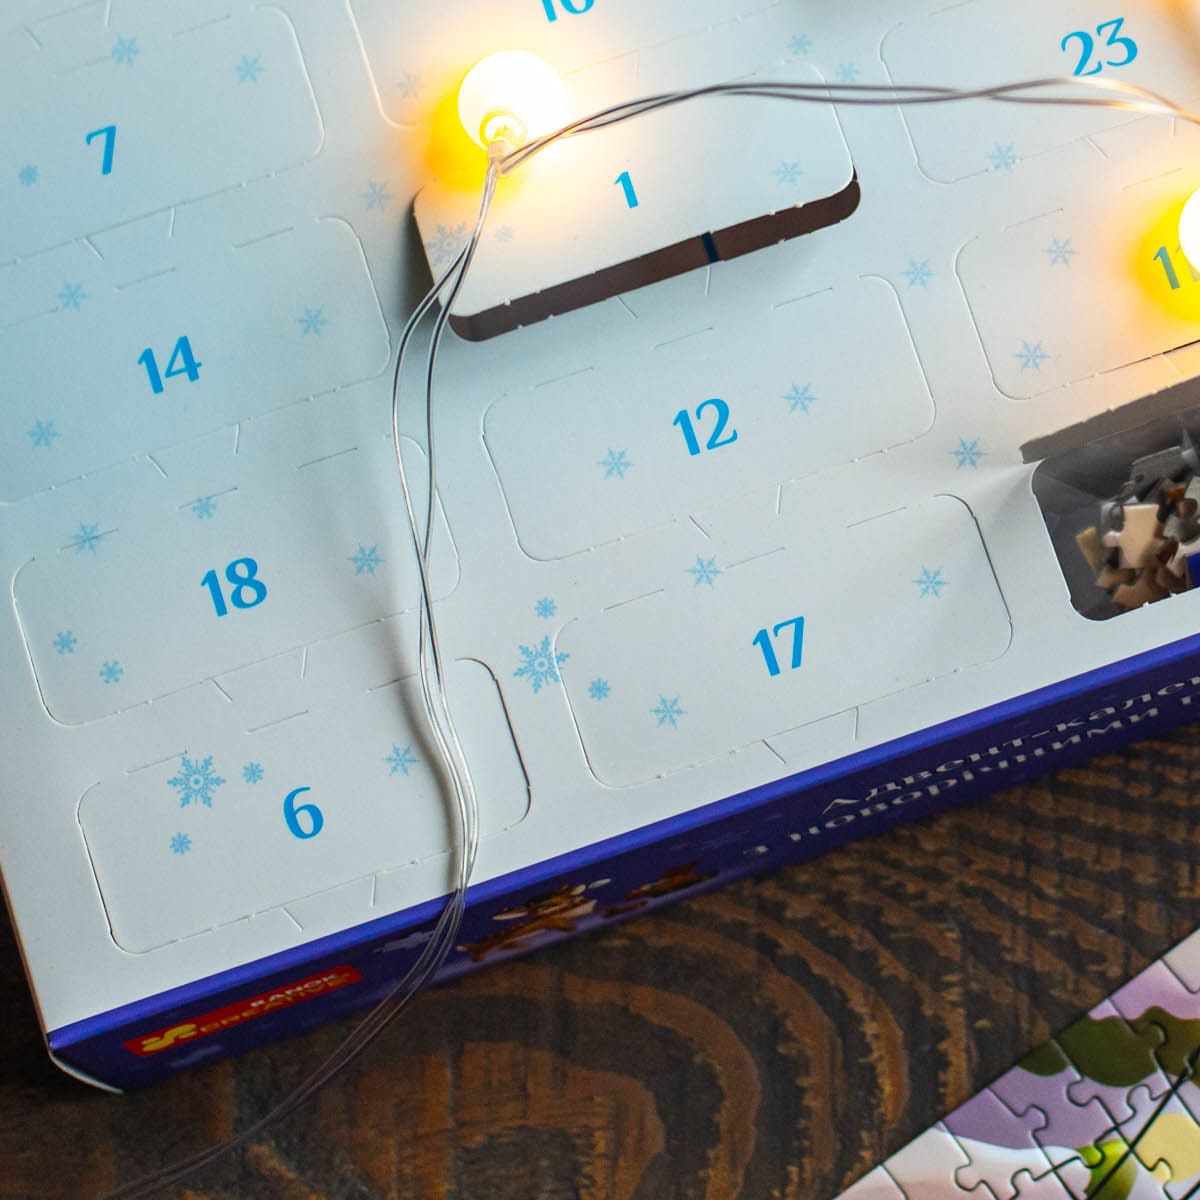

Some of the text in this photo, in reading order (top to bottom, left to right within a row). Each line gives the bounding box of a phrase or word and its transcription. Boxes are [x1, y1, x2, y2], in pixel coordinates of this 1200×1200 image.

[1060, 17, 1138, 77] 23
[84, 124, 118, 177] 7
[614, 171, 640, 210] 1
[136, 335, 203, 395] 14
[672, 397, 738, 457] 12
[200, 556, 268, 618] 18
[751, 615, 806, 677] 17
[788, 706, 1158, 842] новорічними
[282, 786, 325, 840] 6
